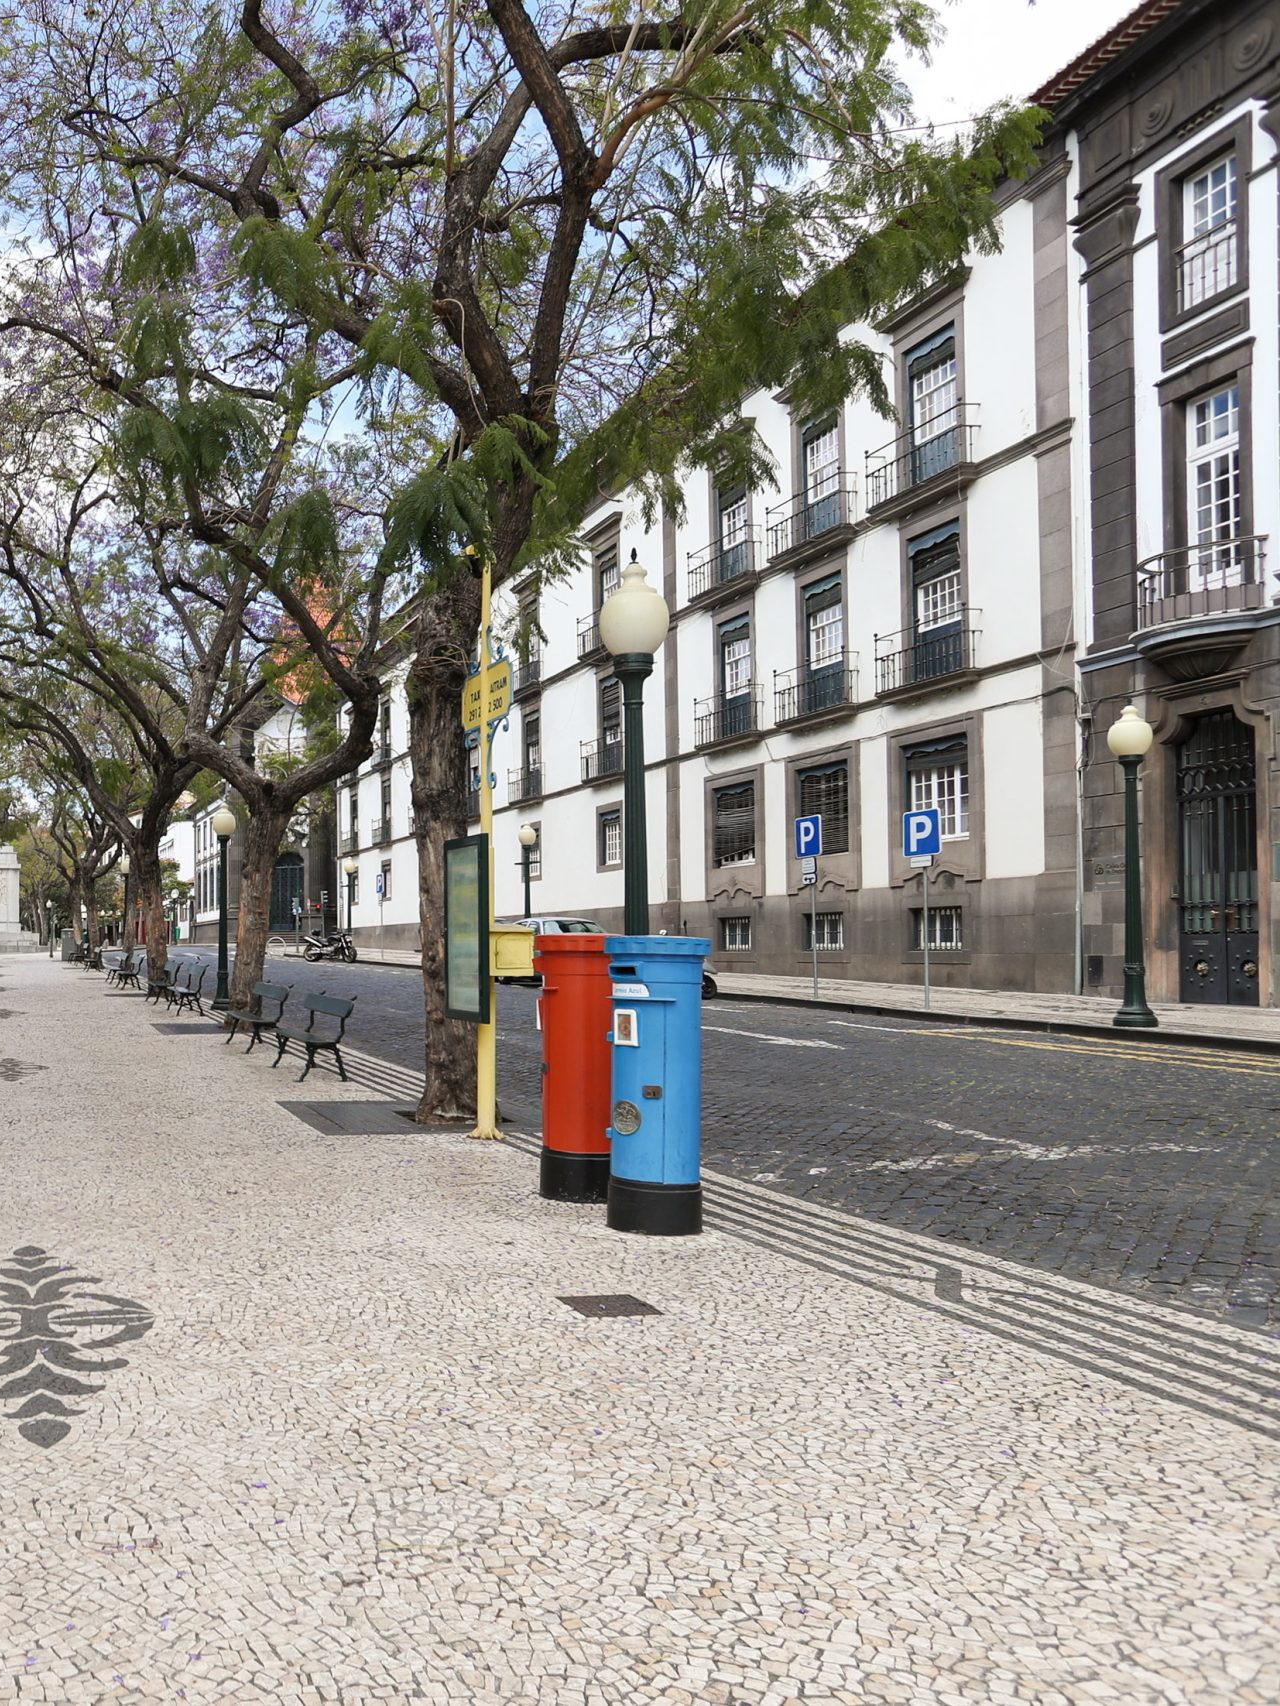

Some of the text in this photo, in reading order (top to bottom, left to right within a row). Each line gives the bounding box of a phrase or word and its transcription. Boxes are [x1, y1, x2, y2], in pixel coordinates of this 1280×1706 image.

[490, 676, 507, 693] AITRAM
[492, 696, 503, 711] 500
[800, 821, 815, 854] P
[909, 815, 933, 852] P
